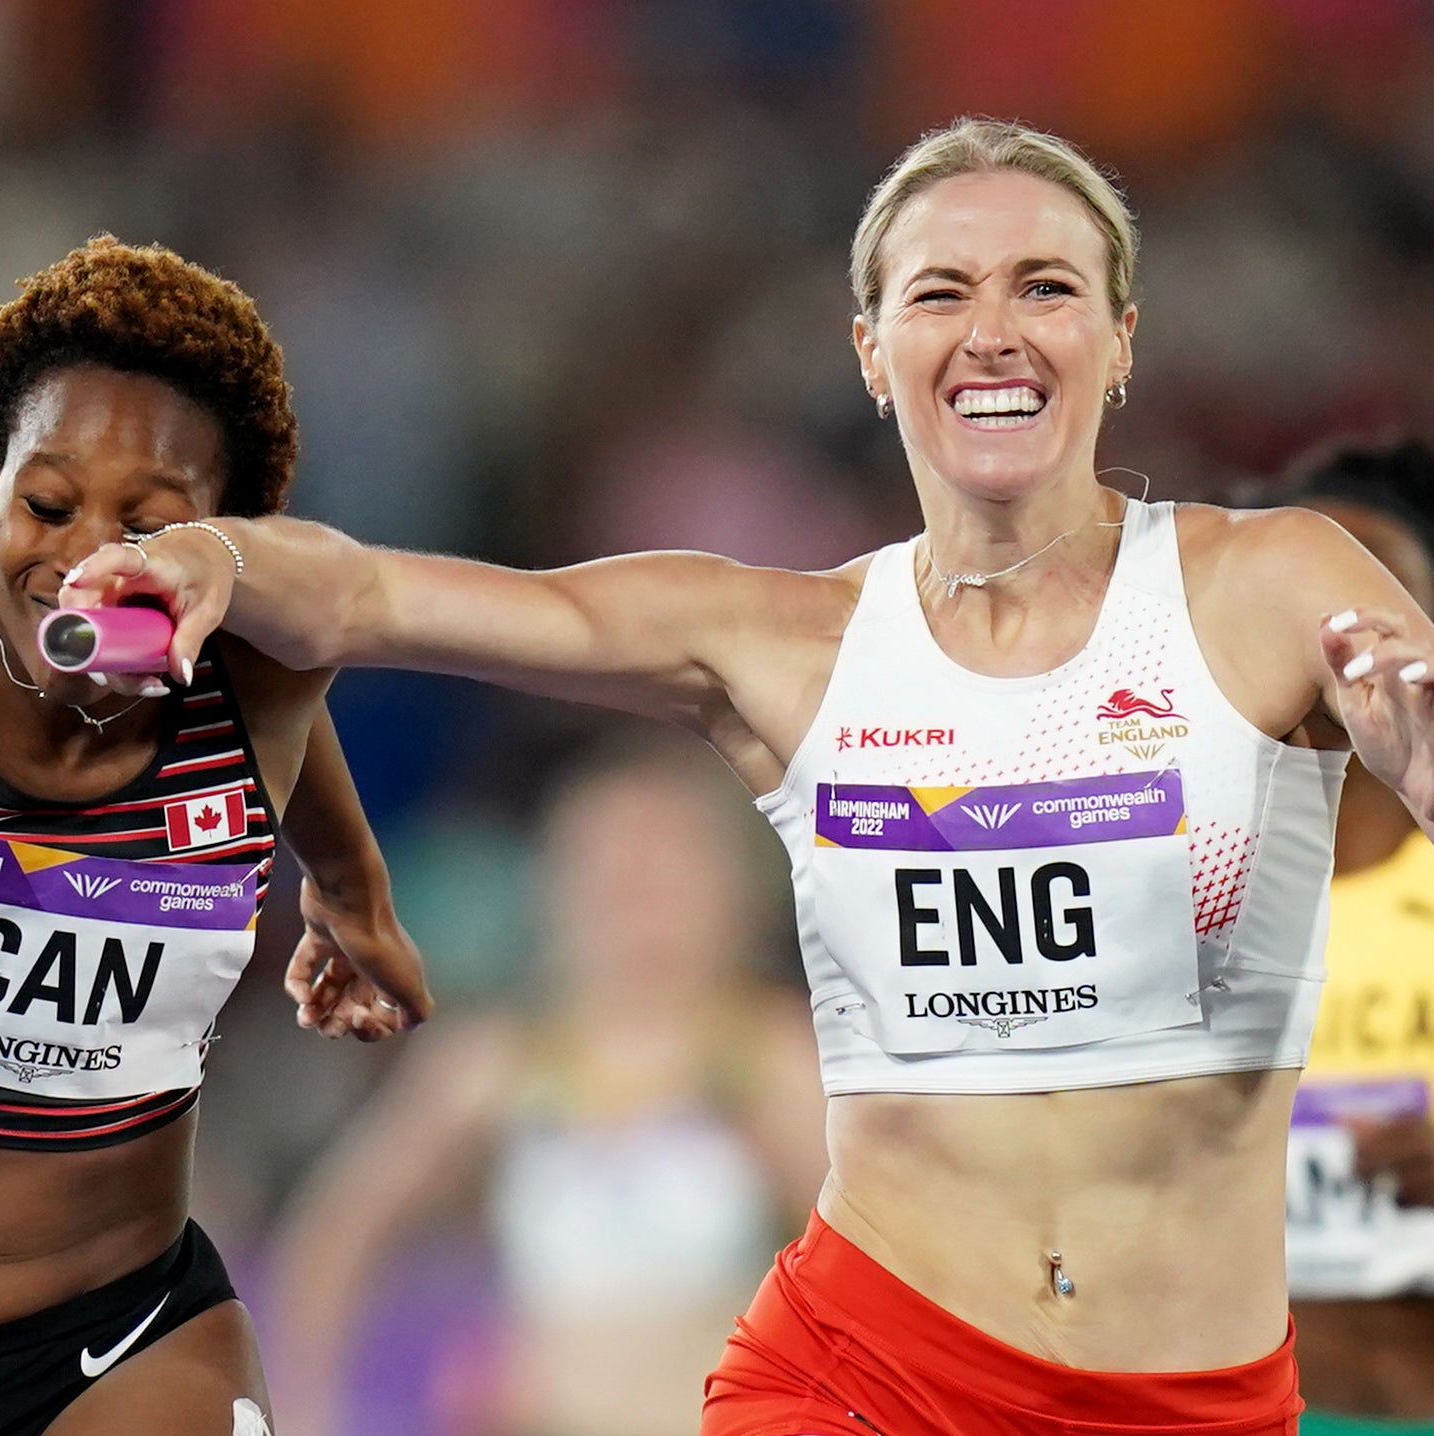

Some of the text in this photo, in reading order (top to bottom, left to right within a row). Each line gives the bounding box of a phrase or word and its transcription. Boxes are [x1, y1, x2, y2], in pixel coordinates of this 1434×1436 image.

[1109, 718, 1141, 730] TEAM
[860, 728, 954, 748] KUKRI
[1098, 725, 1188, 745] ENGLAND
[829, 799, 910, 820] BIRMINGHAM
[1032, 788, 1165, 814] commonwealth
[851, 818, 883, 836] 2022
[1069, 806, 1131, 829] games
[159, 895, 214, 911] games
[894, 861, 1097, 967] ENG
[906, 984, 1098, 1019] LONGINES
